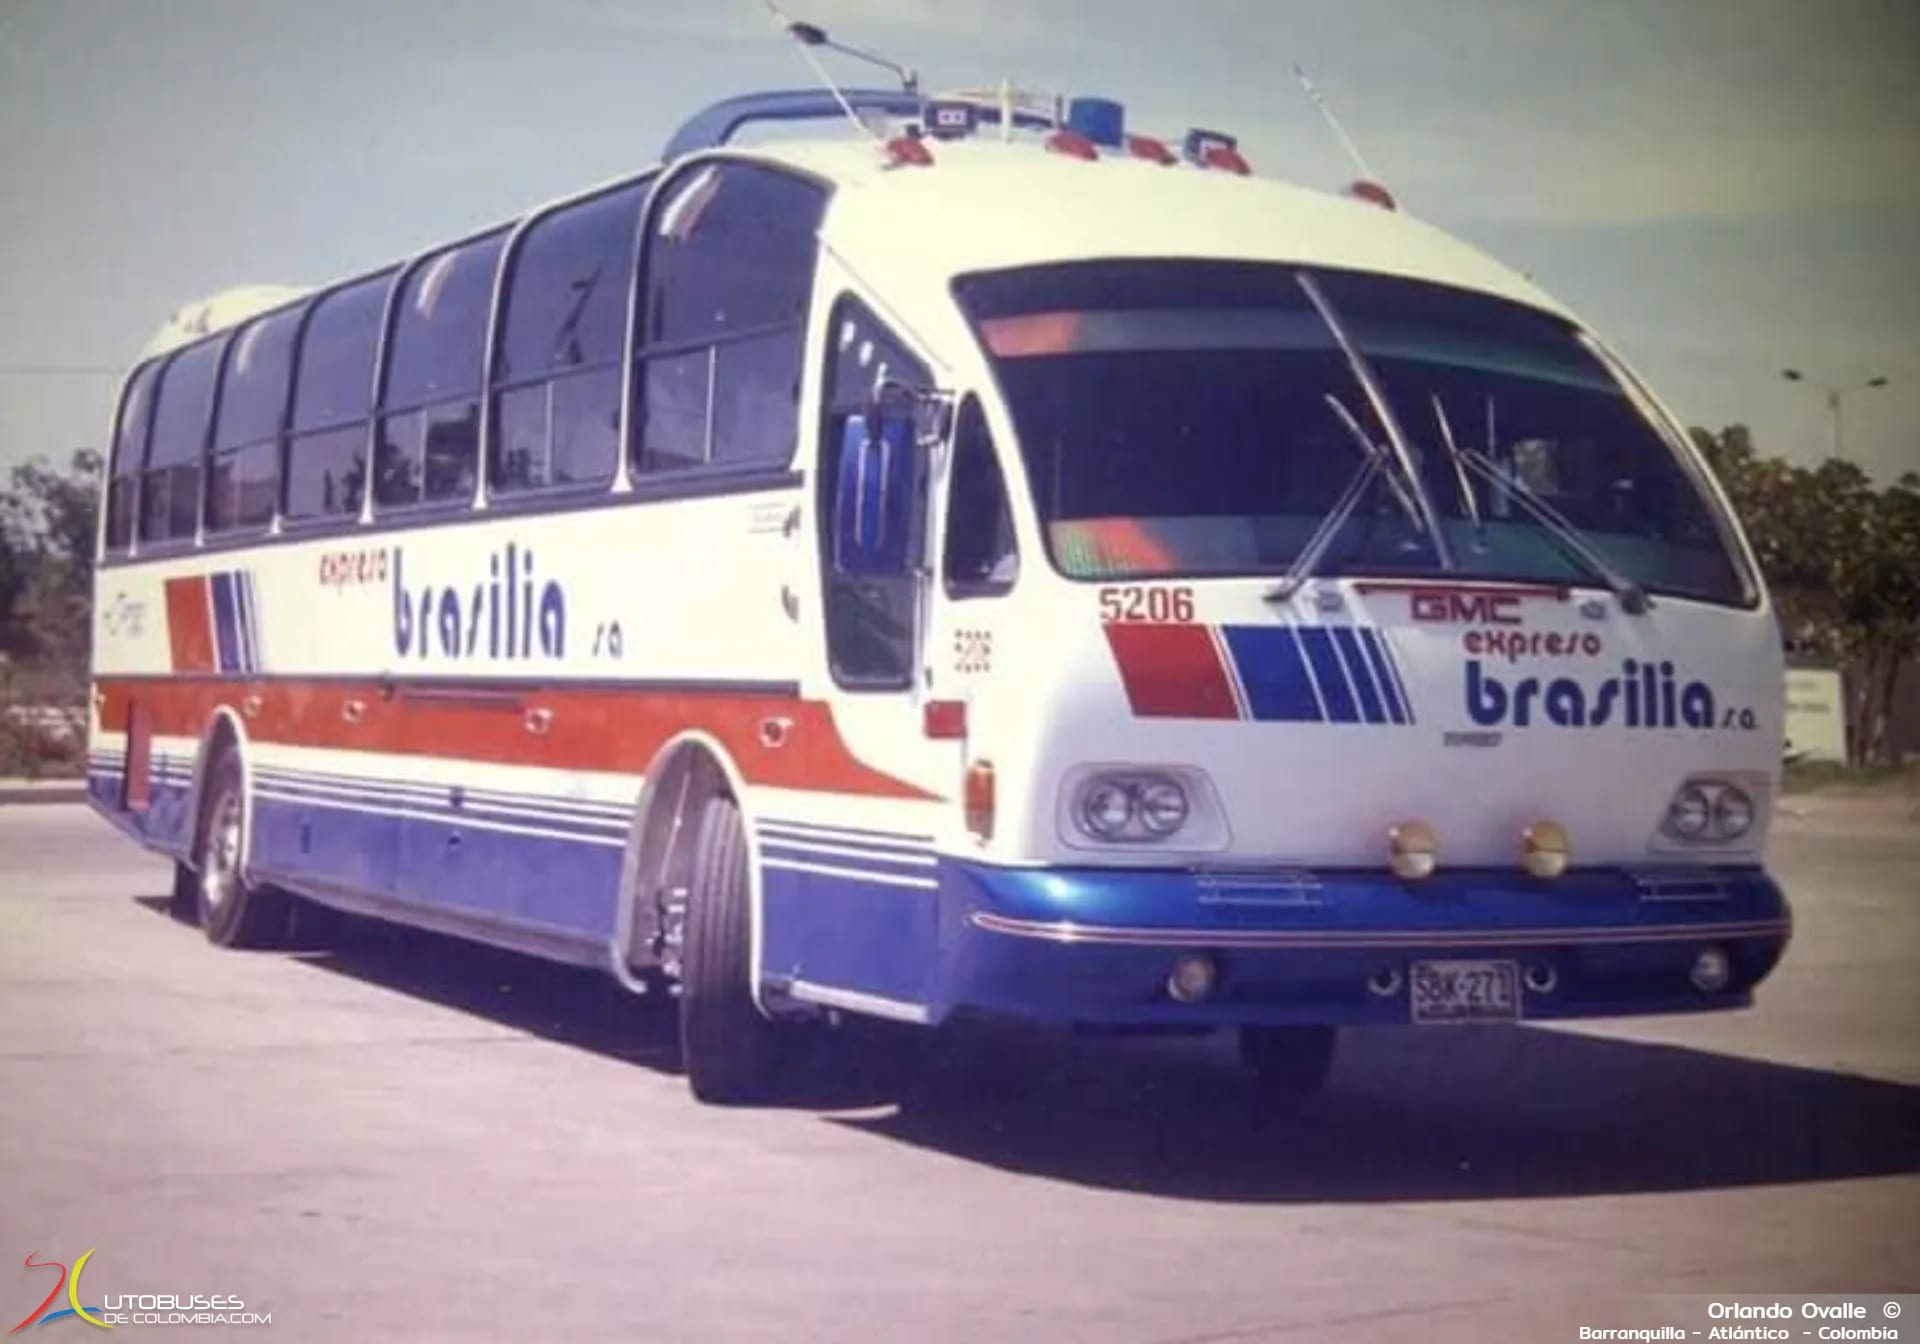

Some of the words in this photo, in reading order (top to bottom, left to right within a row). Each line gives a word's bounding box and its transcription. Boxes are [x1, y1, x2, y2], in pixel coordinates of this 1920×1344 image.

[319, 548, 387, 594] expreso
[393, 541, 565, 659] brasilia
[1098, 586, 1195, 622] 5206
[1411, 593, 1522, 625] GMC
[953, 628, 993, 674] 5206
[1463, 629, 1603, 664] expreso
[1465, 658, 1716, 728] brasilia
